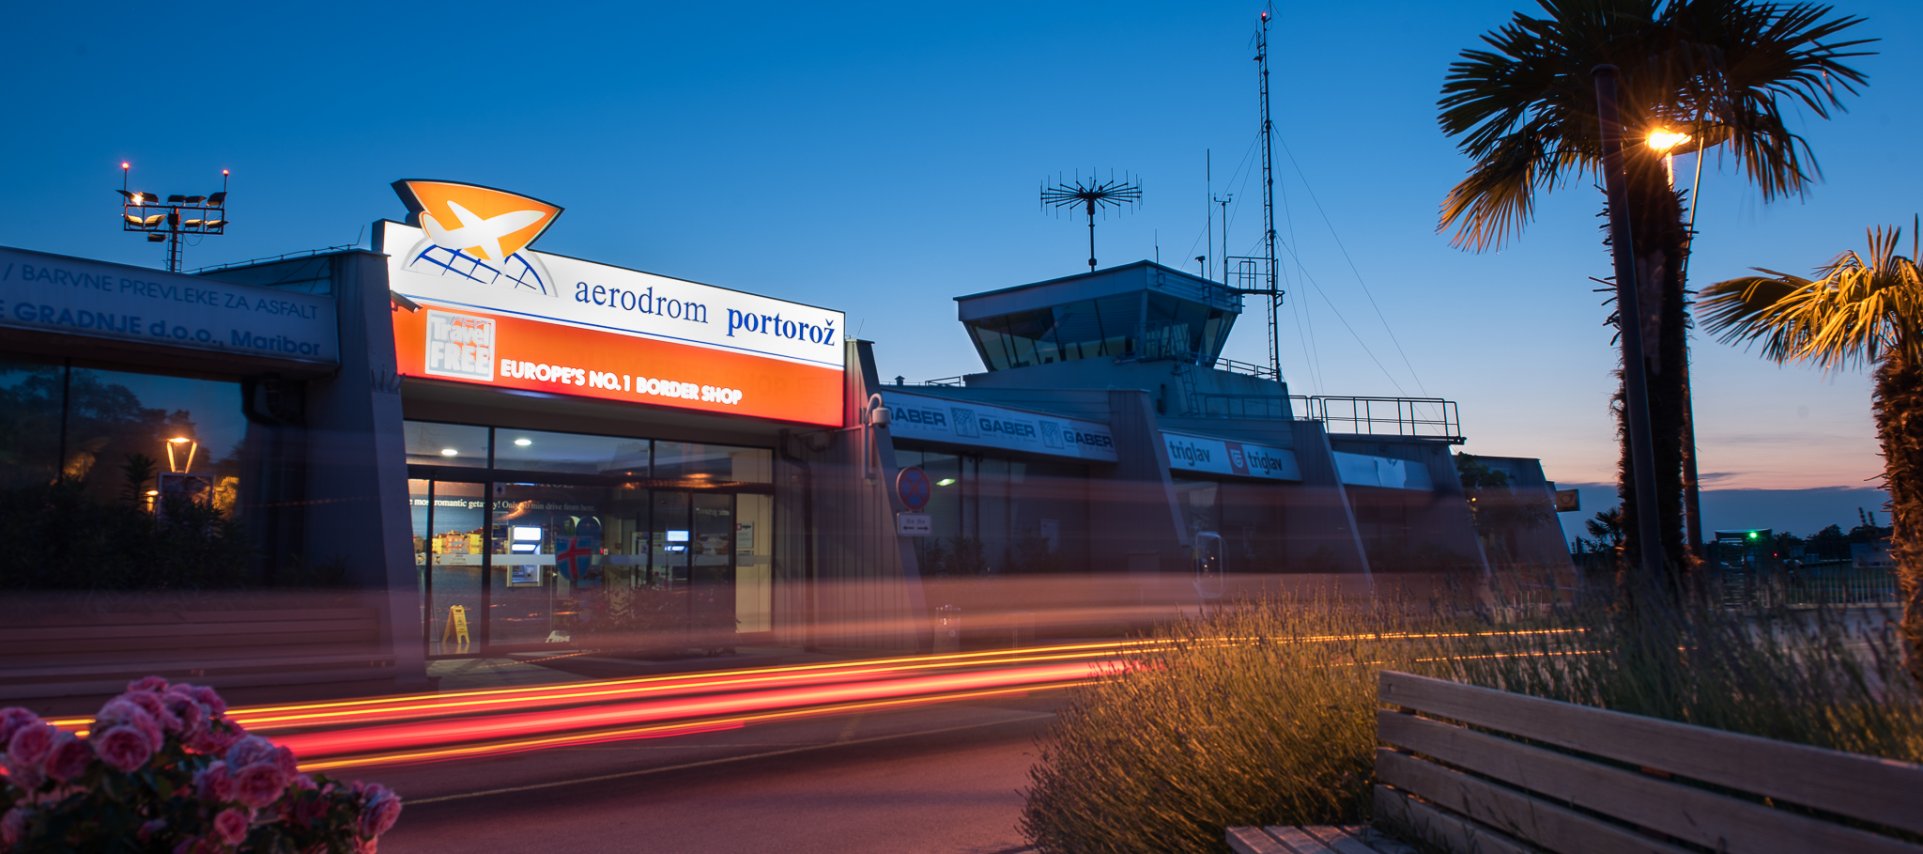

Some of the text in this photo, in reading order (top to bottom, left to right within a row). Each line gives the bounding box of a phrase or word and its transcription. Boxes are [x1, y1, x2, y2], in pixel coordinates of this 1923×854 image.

[22, 264, 113, 292] BARVNE
[120, 278, 219, 306] PREVLEKE
[224, 292, 249, 311] ZA
[256, 299, 318, 320] ASFALT
[13, 302, 142, 334] GRADNJE
[151, 319, 224, 346] d.o.o.,
[231, 329, 320, 356] Maribor
[574, 281, 836, 347] aerodrom portorož
[431, 316, 491, 347] Travel
[430, 340, 491, 375] FREE
[500, 359, 585, 386] EUROPE'S
[636, 377, 700, 400] BORDER
[701, 385, 743, 405] SHOP
[979, 417, 1036, 438] GABER
[1063, 430, 1113, 448] GABER
[1169, 441, 1211, 466] triglav
[1247, 451, 1283, 475] triglav
[434, 498, 467, 507] romantic
[468, 500, 501, 511] getay!
